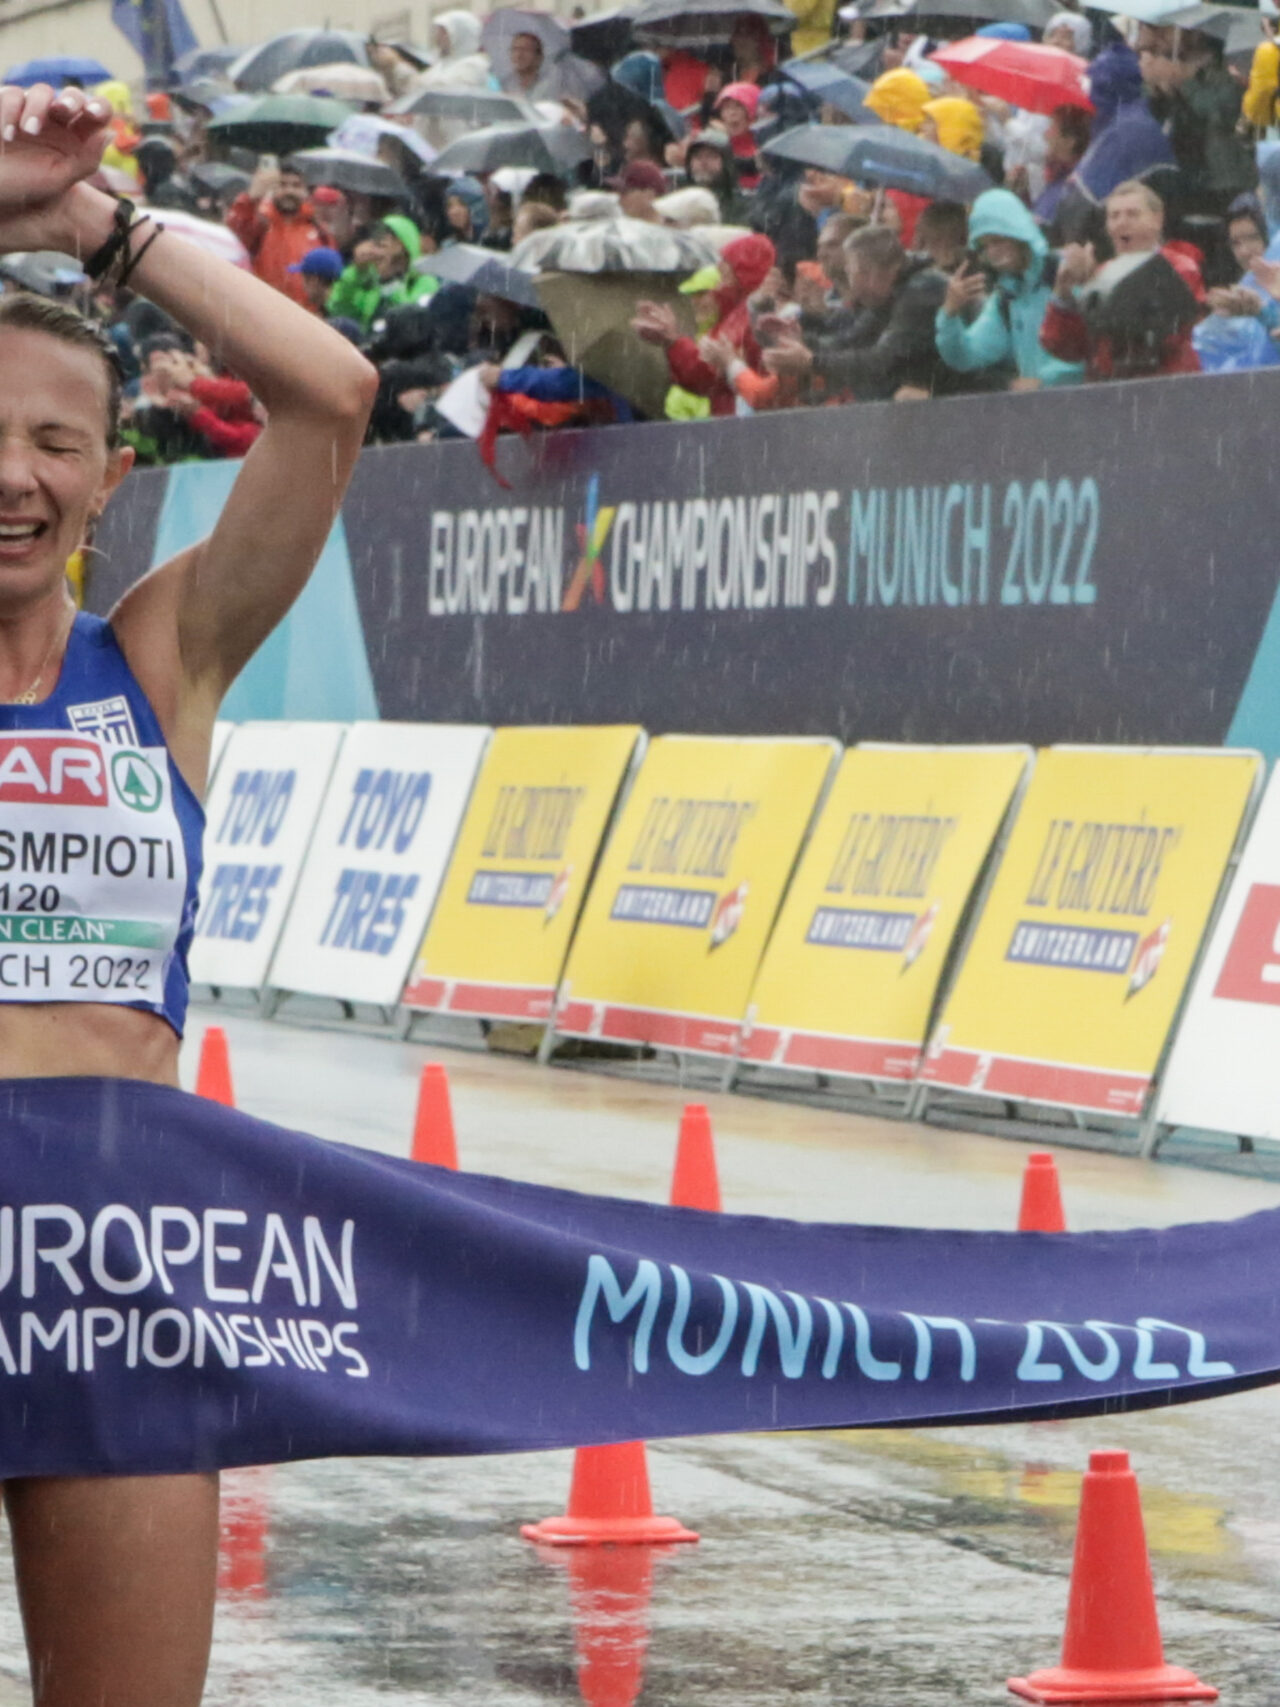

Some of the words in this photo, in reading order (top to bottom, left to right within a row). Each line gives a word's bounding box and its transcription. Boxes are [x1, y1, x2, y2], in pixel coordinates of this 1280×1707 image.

[429, 508, 564, 614] EUROPEAN
[611, 490, 840, 612] CHAMPIONSHIPS
[847, 484, 992, 606] MUNICH
[1001, 476, 1101, 605] 2022
[215, 768, 297, 847] TOYO
[337, 768, 432, 855] TOYO
[195, 863, 283, 943] TIRES
[318, 867, 421, 957] TIRES
[69, 955, 152, 990] 2022
